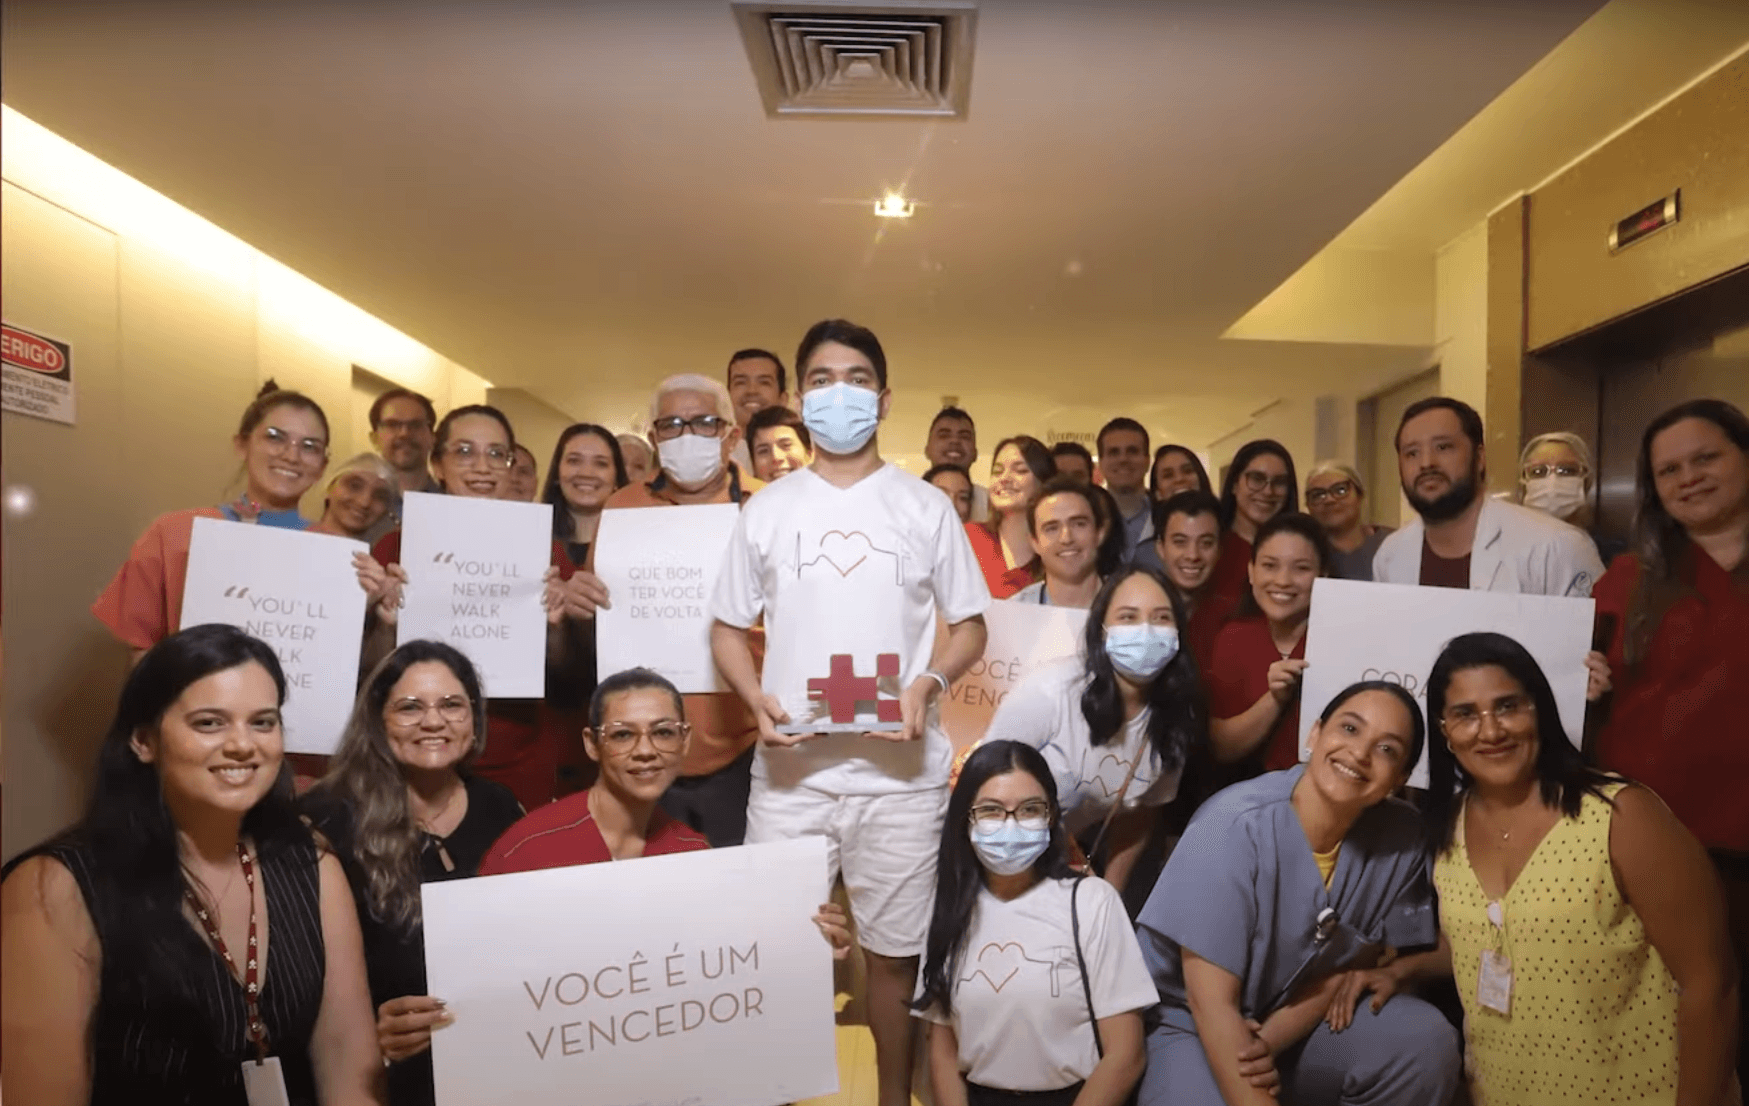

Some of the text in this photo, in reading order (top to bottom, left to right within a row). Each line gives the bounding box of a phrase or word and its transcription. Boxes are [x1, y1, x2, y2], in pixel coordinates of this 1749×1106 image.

[1, 334, 58, 367] ERIGO
[629, 566, 703, 581] QUE BOM
[453, 582, 511, 597] NEVER
[630, 583, 705, 600] TER VOCÊ
[451, 603, 501, 618] WALK
[630, 605, 703, 619] DE VOLTA
[246, 620, 316, 641] NEVER
[450, 624, 511, 640] ALONE
[279, 649, 303, 664] LK
[967, 657, 1022, 682] OCÊ
[1361, 668, 1428, 698] CORA
[523, 941, 759, 1011] VOCÊ É UM
[526, 987, 764, 1060] VENCEDOR
